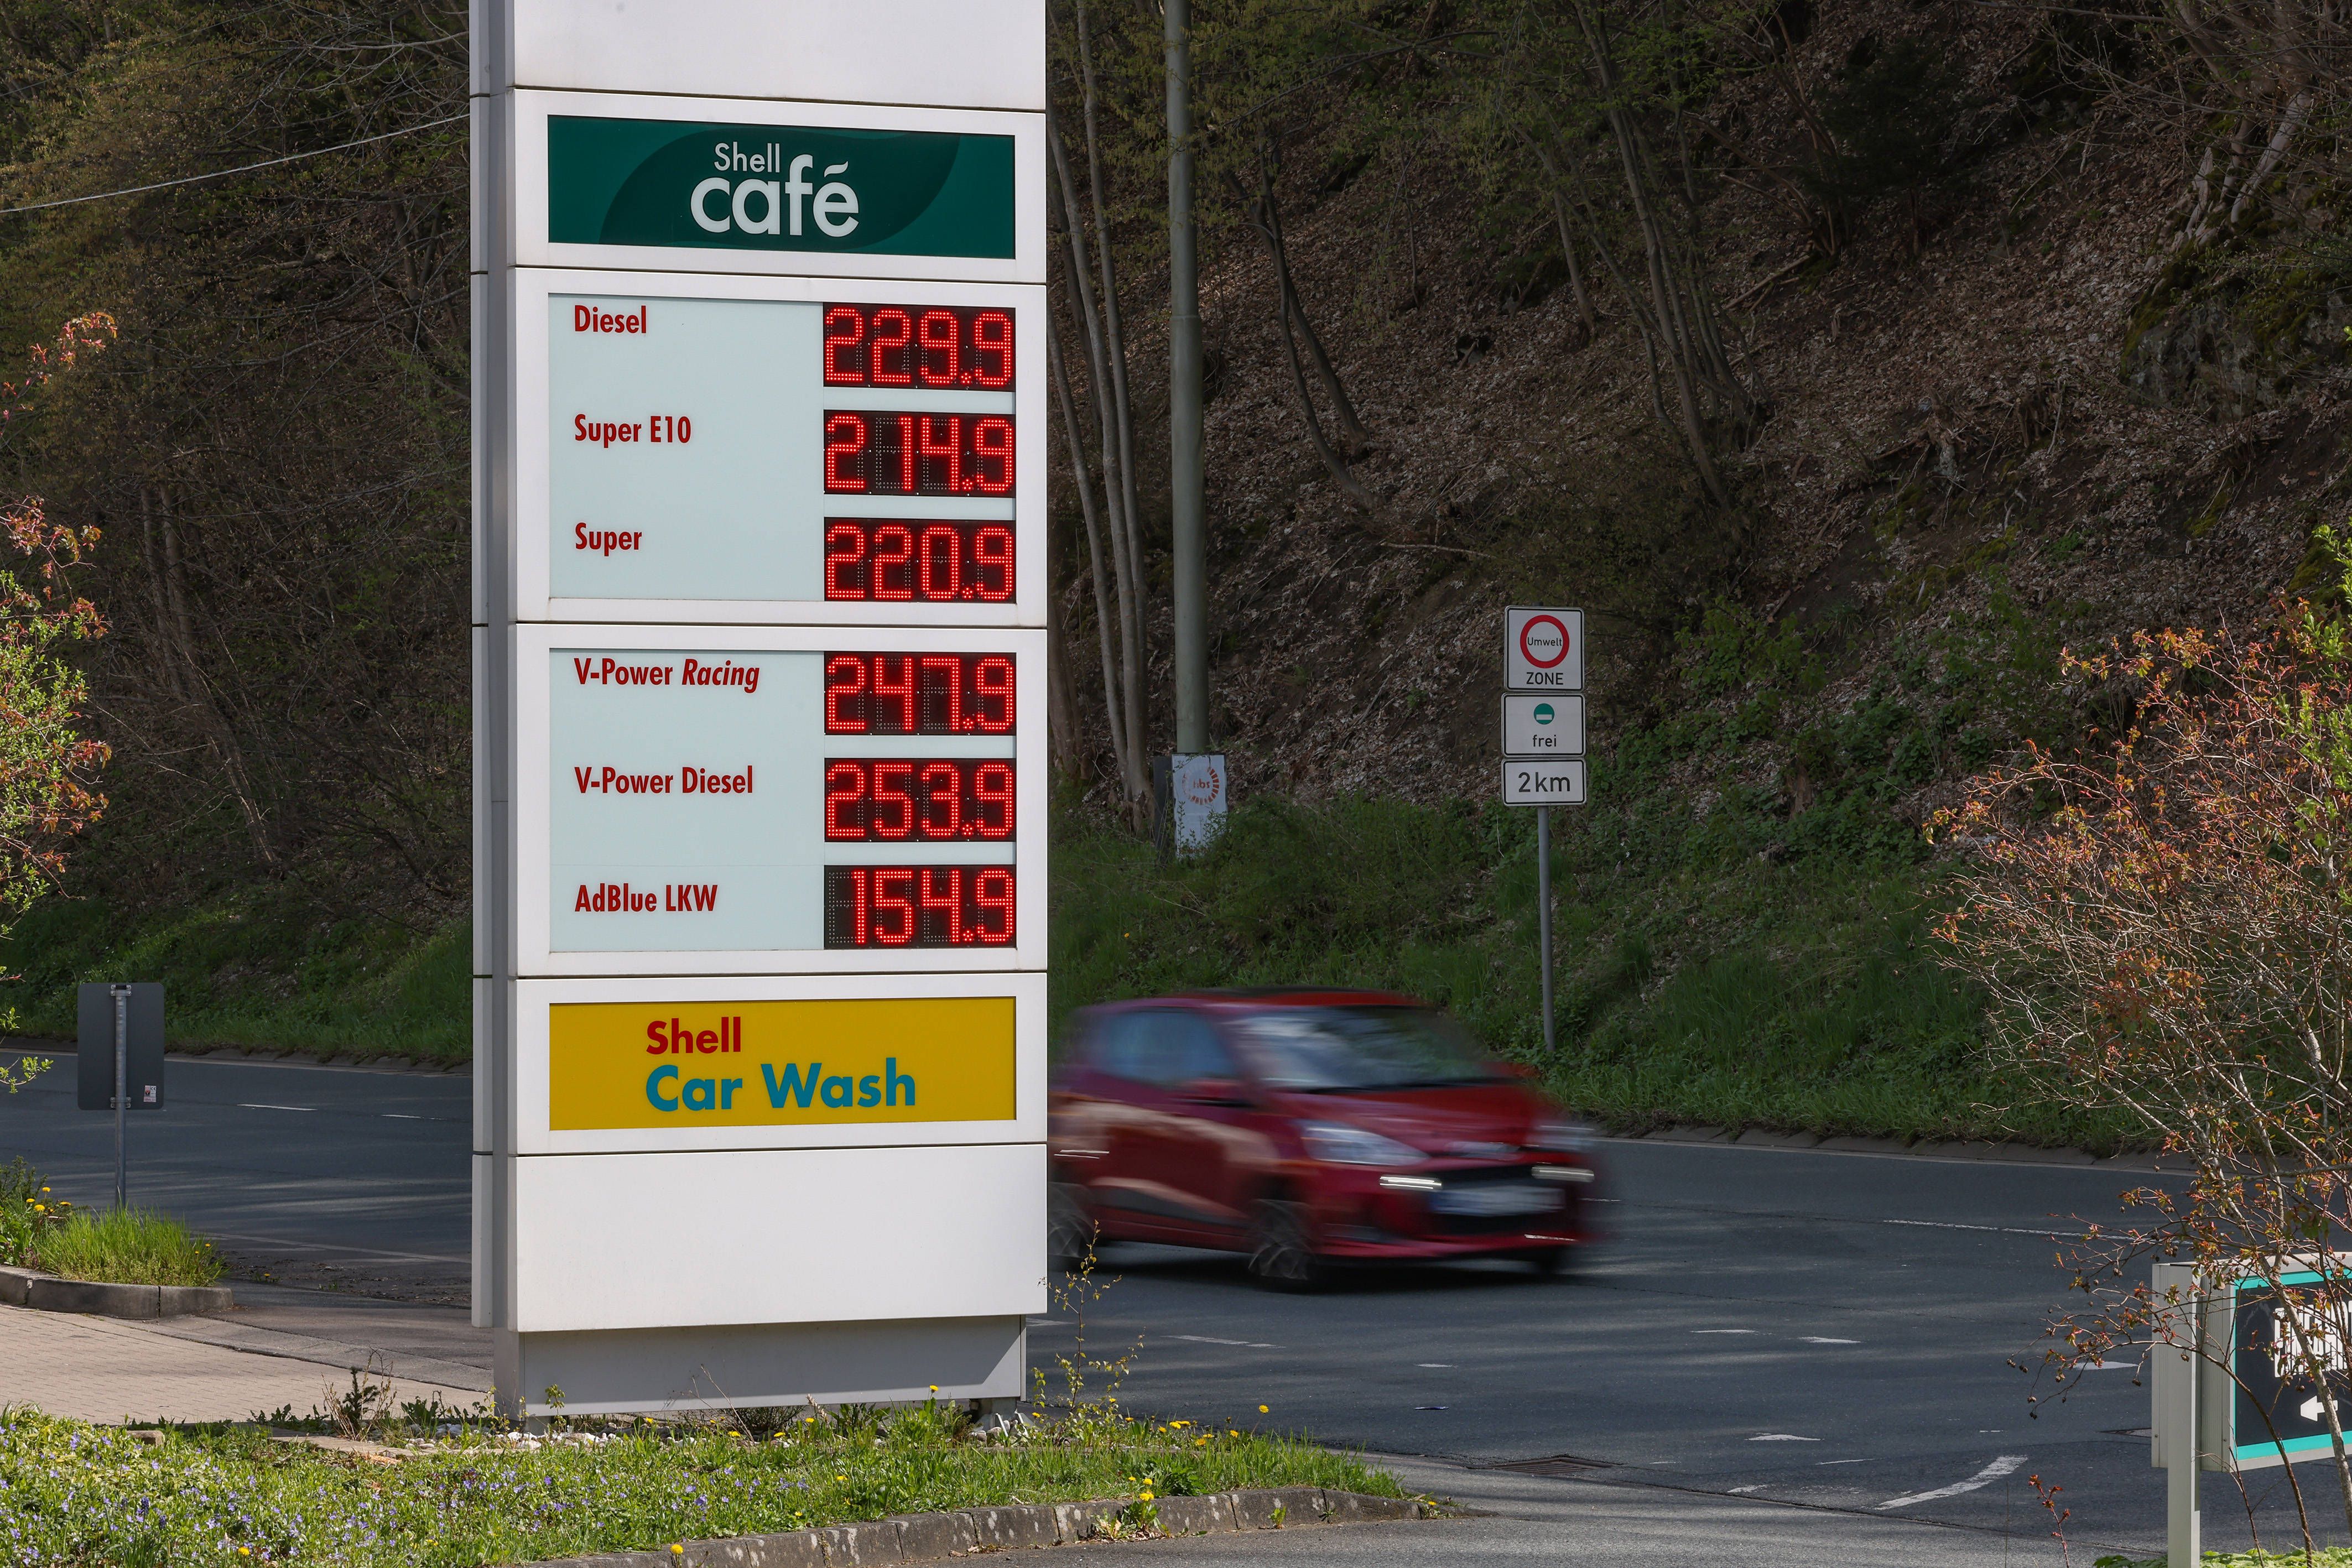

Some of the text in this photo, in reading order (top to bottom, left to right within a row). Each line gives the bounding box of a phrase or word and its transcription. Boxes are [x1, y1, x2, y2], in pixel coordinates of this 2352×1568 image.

[714, 142, 780, 173] Shell
[690, 154, 859, 237] café
[575, 305, 1013, 386] Diesel 229.9
[575, 414, 1014, 493] Super E10 214.9
[575, 522, 1014, 601] Super 220.9
[1526, 671, 1564, 685] ZONE
[1527, 636, 1563, 647] Umwelt
[574, 655, 1014, 731] V-Power Racing 247.9
[1532, 734, 1557, 747] frei
[574, 763, 1014, 837] V-Power Diesel 253.9
[575, 869, 1014, 944] AdBlue LKW 154.9
[646, 1015, 742, 1055] Shell
[646, 1058, 915, 1112] Car Wash
